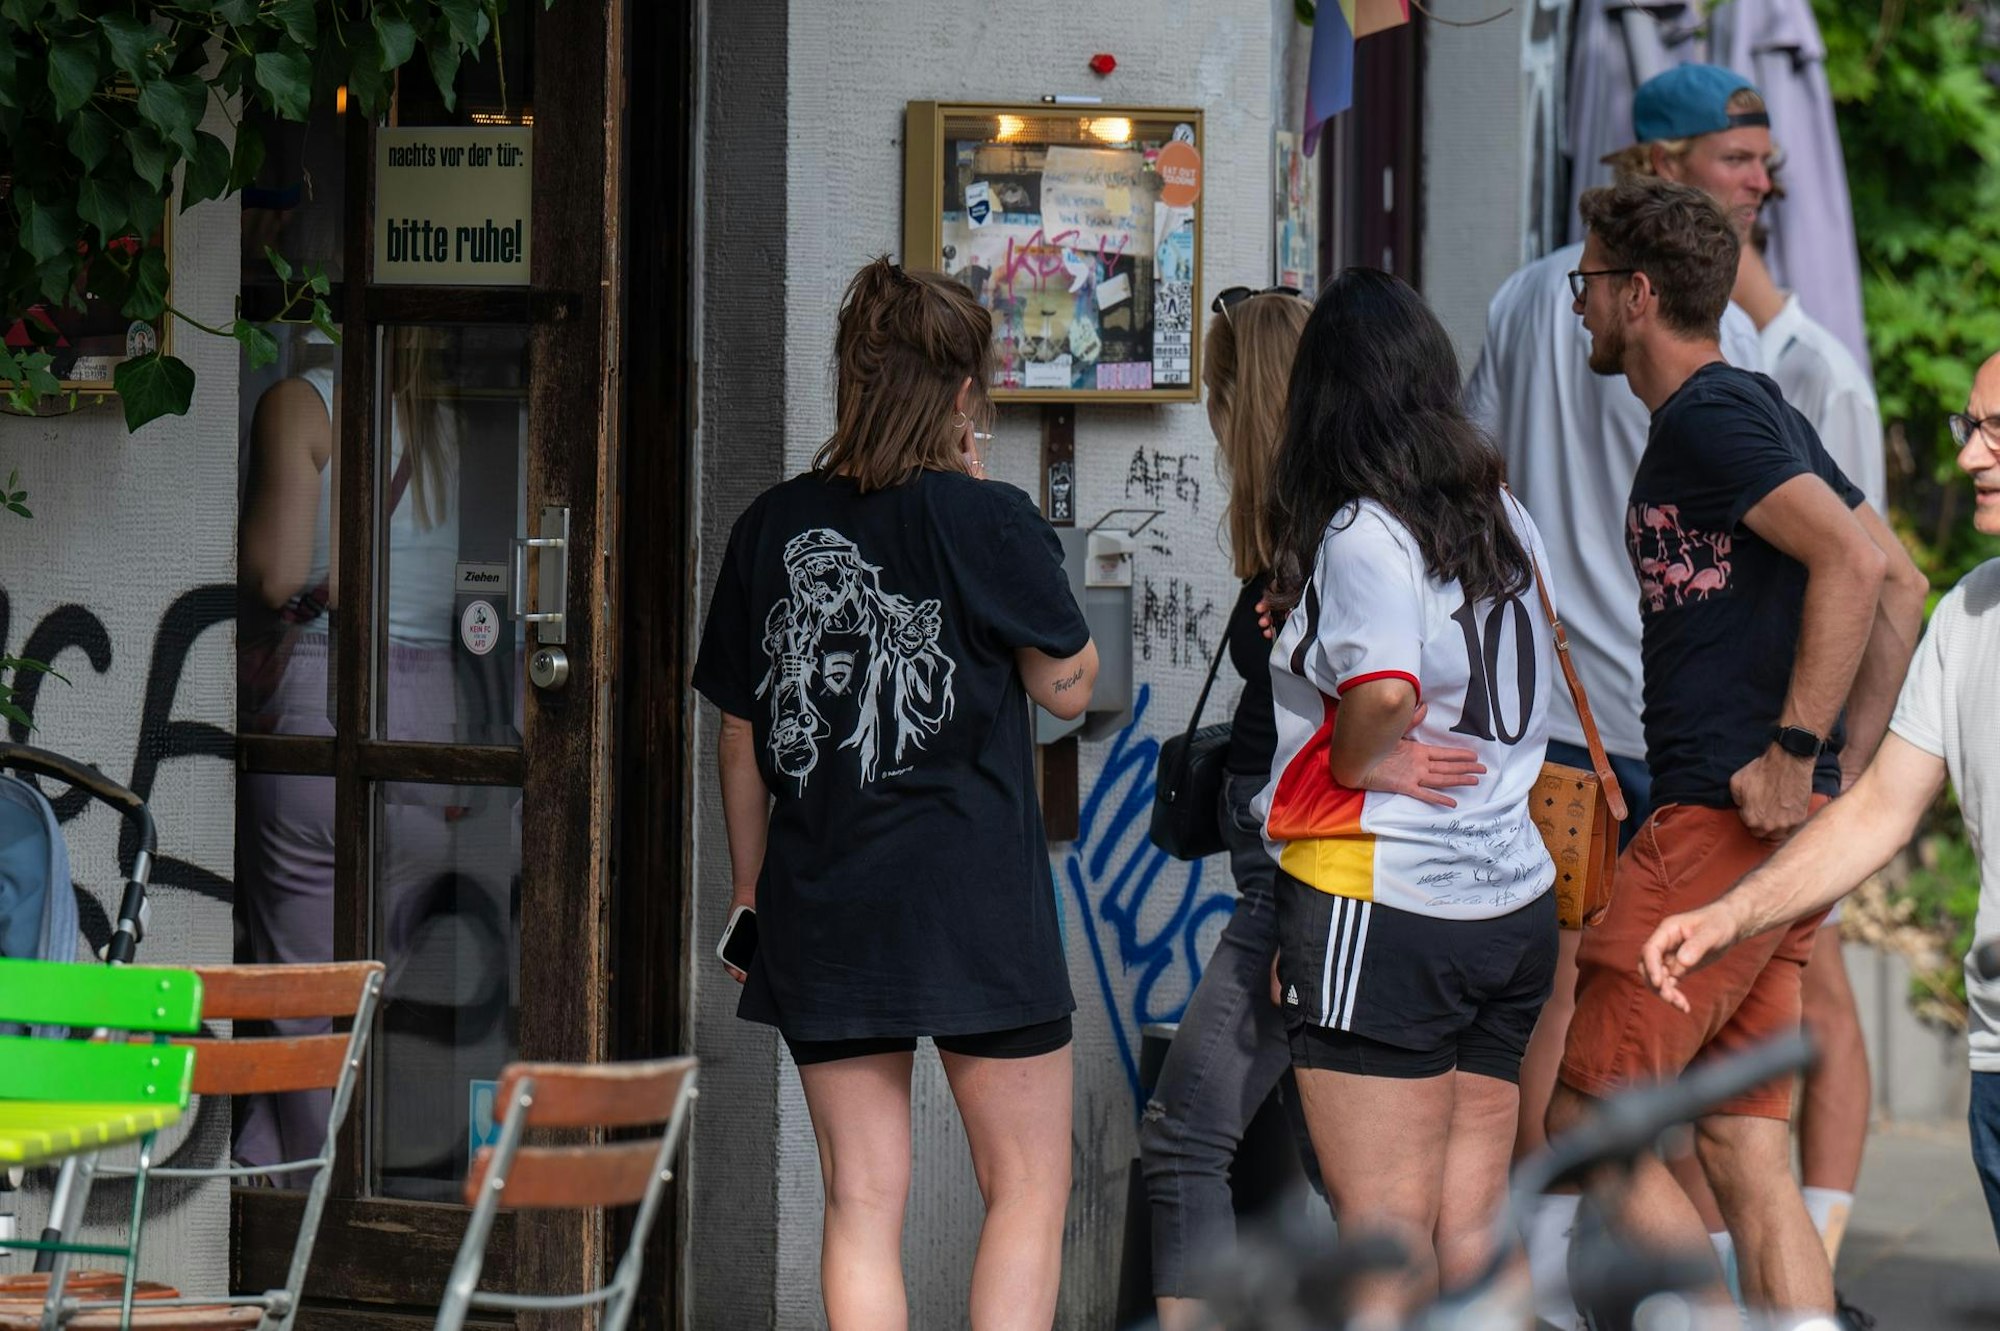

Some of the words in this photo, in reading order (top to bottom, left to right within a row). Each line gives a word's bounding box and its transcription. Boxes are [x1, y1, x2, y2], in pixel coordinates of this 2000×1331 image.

[388, 143, 436, 167] nachts
[440, 146, 464, 167] vor
[468, 143, 492, 167] der
[497, 143, 523, 167] tür:
[387, 218, 448, 262] bitte
[456, 219, 522, 262] ruhe!
[464, 571, 500, 582] Ziehen
[470, 625, 483, 633] KEIN
[1449, 596, 1536, 745] 10
